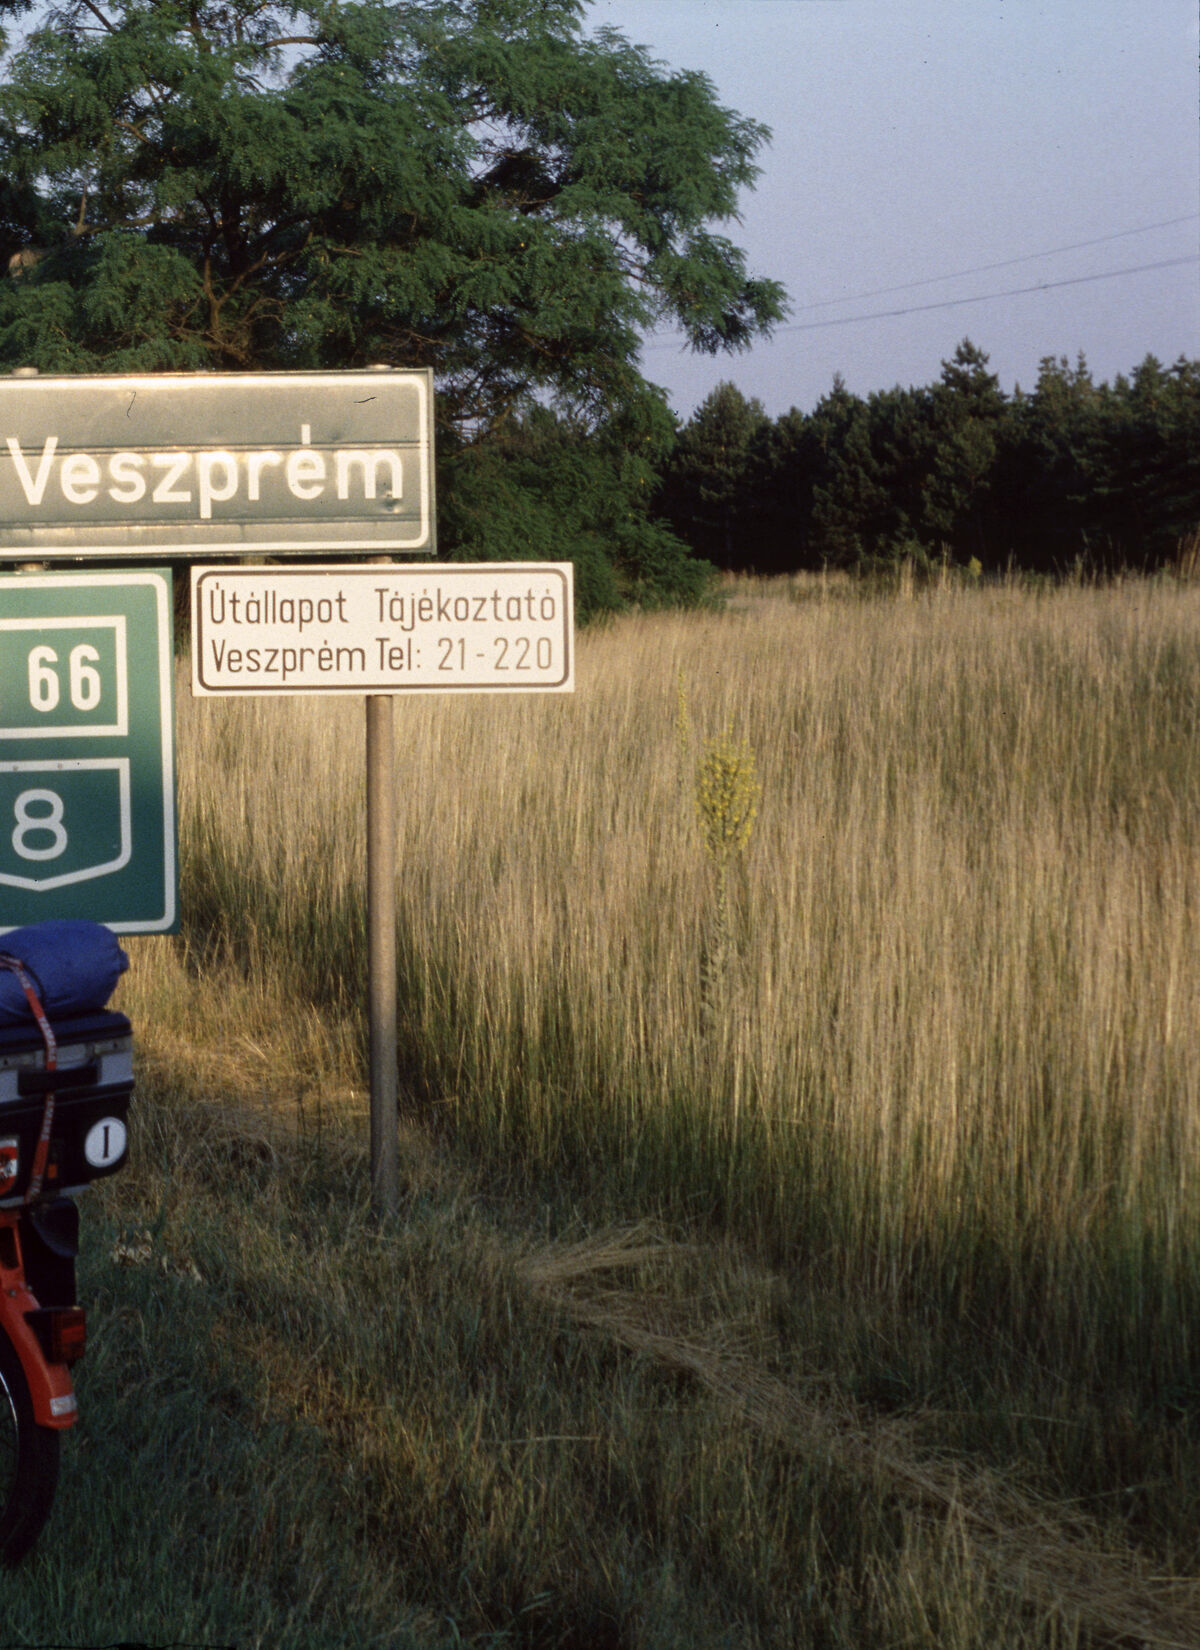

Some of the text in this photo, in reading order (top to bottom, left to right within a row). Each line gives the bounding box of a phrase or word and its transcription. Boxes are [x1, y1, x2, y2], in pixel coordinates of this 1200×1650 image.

[6, 424, 403, 519] Veszprém
[210, 582, 555, 632] Útállapot Tájékoztató
[28, 643, 102, 712] 66
[211, 639, 366, 681] Veszprém
[375, 637, 421, 672] Tel:
[12, 788, 68, 861] 8
